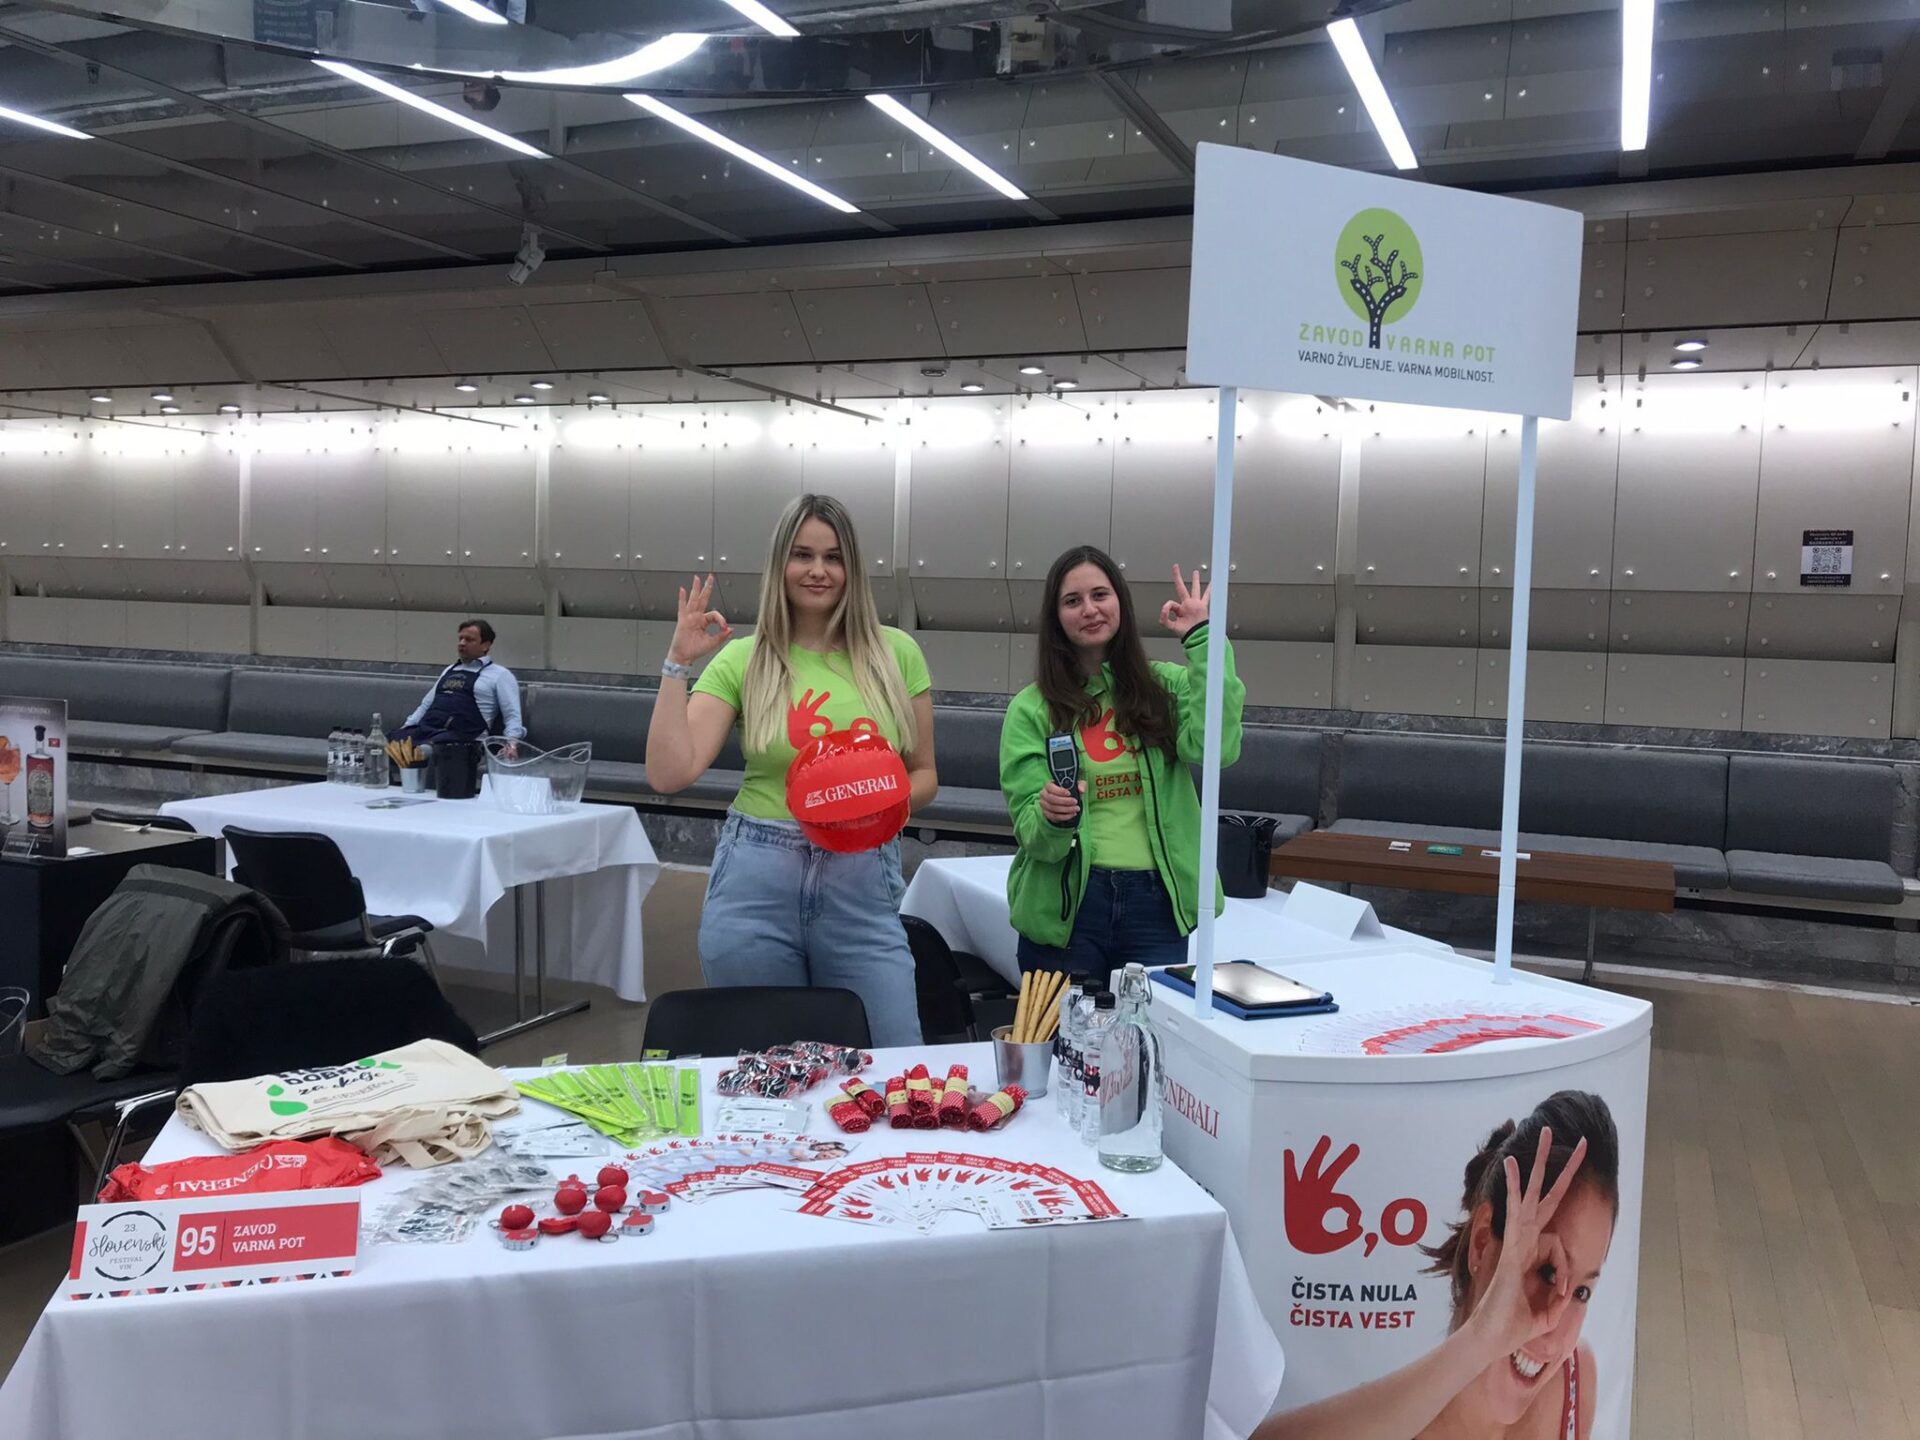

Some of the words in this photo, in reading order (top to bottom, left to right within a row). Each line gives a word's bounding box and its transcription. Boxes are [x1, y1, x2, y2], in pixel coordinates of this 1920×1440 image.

[1298, 323, 1364, 347] ZAVOD
[1386, 334, 1455, 358] VARNA
[1462, 344, 1496, 363] POT
[1298, 350, 1335, 365] VARNO
[1337, 352, 1395, 373] ŽIVLJENJE.
[1397, 362, 1433, 376] VARNA
[1434, 367, 1495, 383] MOBILNOST.
[825, 774, 898, 802] GENERALI
[1095, 774, 1130, 787] ČISTA
[1096, 787, 1131, 800] ČISTA
[173, 1154, 273, 1192] GENERAL
[88, 1231, 168, 1257] Slovenski
[181, 1226, 217, 1257] 95
[233, 1224, 277, 1238] ZAVOD
[232, 1239, 276, 1254] VARNA
[279, 1236, 305, 1250] POT
[109, 1256, 143, 1264] FESTIVAL
[1291, 1276, 1354, 1302] ČISTA
[1360, 1283, 1418, 1302] NULA
[1290, 1303, 1353, 1329] ČISTA
[1359, 1310, 1416, 1329] VEST
